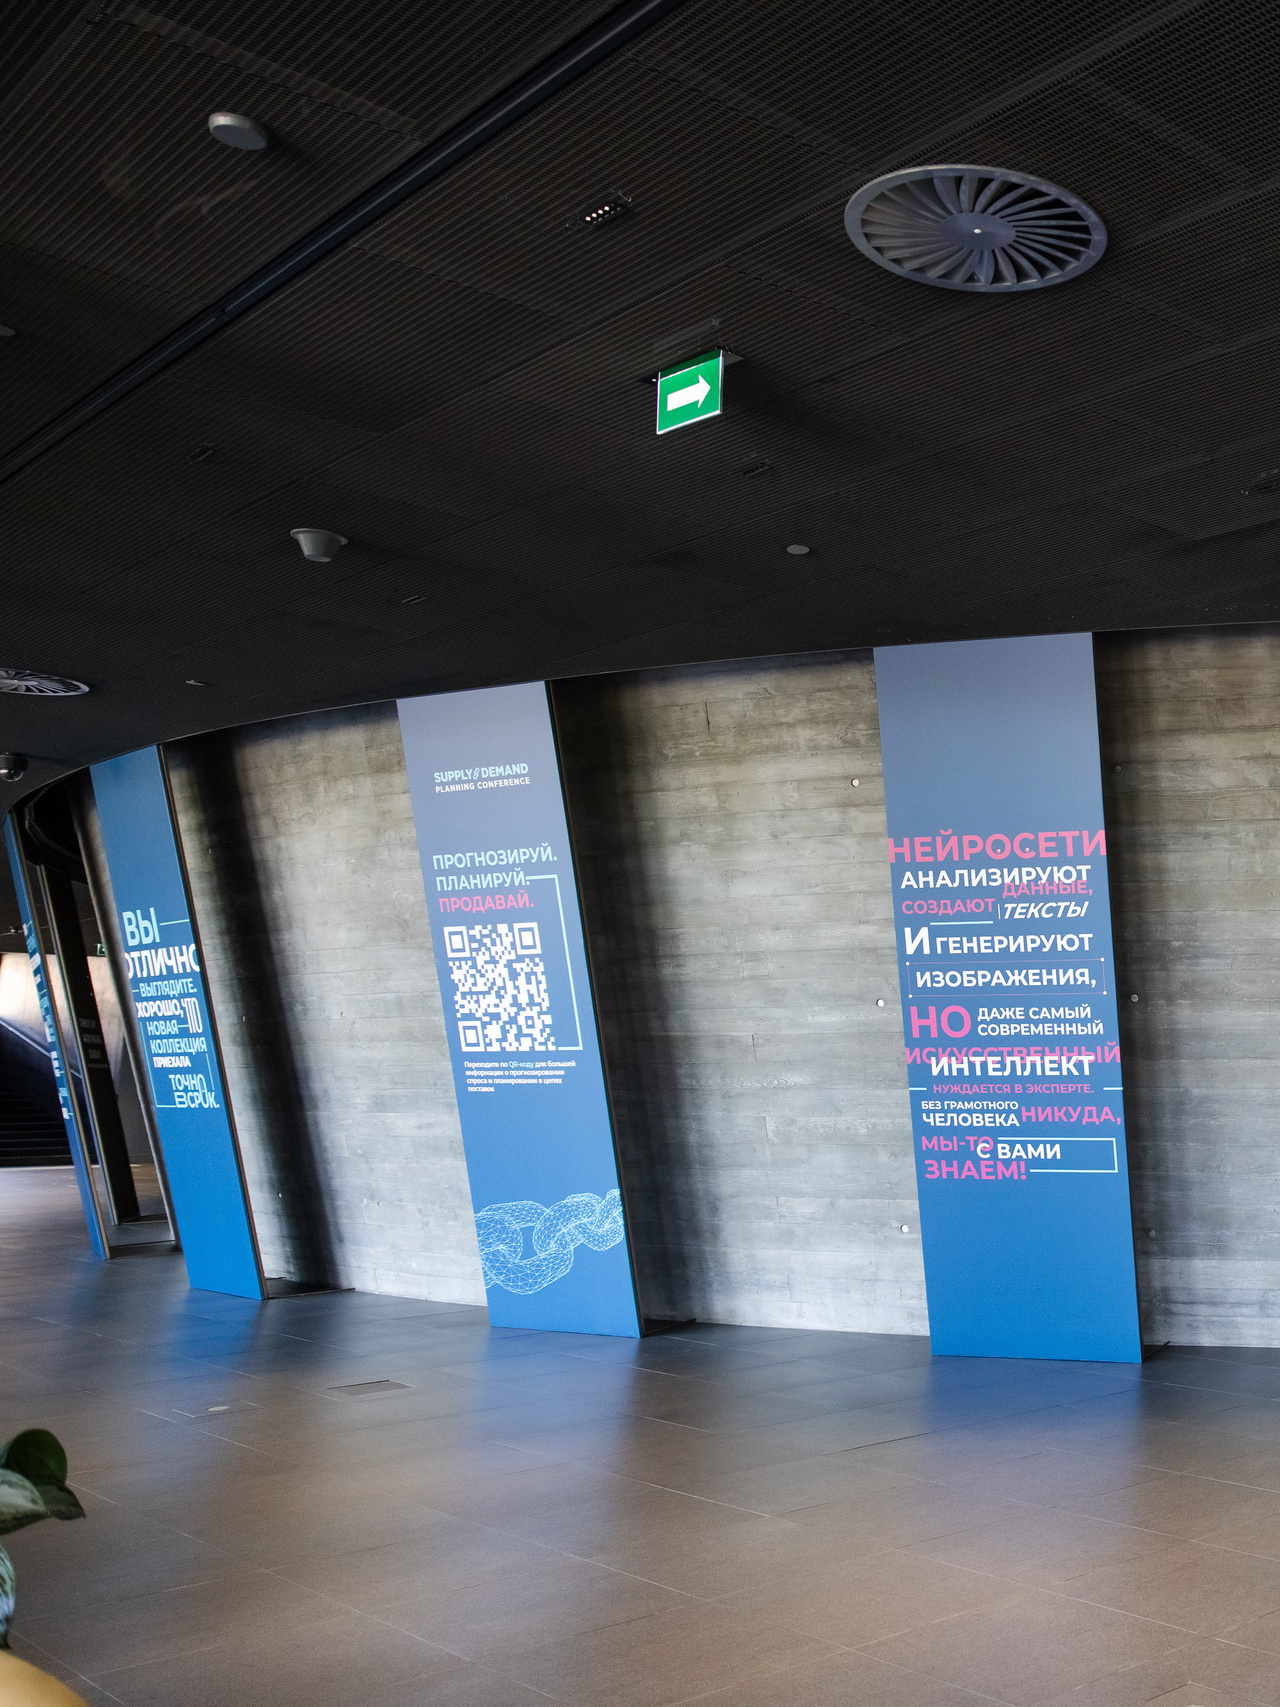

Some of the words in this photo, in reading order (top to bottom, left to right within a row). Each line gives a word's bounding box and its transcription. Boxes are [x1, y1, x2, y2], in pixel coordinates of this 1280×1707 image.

[434, 768, 472, 783] SUPPLY
[481, 763, 529, 778] DEMAND
[435, 782, 475, 793] PLANNING
[477, 777, 531, 789] CONFERENCE
[888, 828, 1107, 863] НЕЙРОСЕТИ
[432, 842, 558, 870] ПРОГНОЗИРУЙ.
[435, 867, 530, 892] ПЛАНИРУЙ.
[901, 865, 1091, 889] АНАЛИЗИРУЮТ
[1002, 880, 1093, 898] ДАННЫЕ,
[438, 889, 534, 914] ПРОДАВАЙ.
[901, 898, 995, 916] СОЗДАЮТ
[1003, 901, 1089, 919] ТЕКСТЫ
[122, 907, 160, 947] ВЫ
[904, 926, 931, 955] И
[936, 933, 1093, 954] ГЕНЕРИРУЮТ
[139, 978, 197, 998] ВЫГЛЯДИТЕ.
[916, 968, 1097, 988] ИЗОБРАЖЕНИЯ,
[135, 999, 184, 1018] ХОРОШО,
[180, 997, 203, 1033] ЧТО
[910, 1005, 971, 1038] НО
[977, 1007, 1025, 1021] ДАЖЕ
[1028, 1004, 1092, 1020] САМЫЙ
[146, 1020, 179, 1036] НОВАЯ
[977, 1020, 1104, 1036] СОВРЕМЕННЫЙ
[149, 1037, 208, 1055] КОЛЛЕКЦИЯ
[905, 1041, 1121, 1065] ИСКУССТВЕННЫЙ
[153, 1056, 192, 1068] ПРИЕХАЛА
[508, 1061, 534, 1069] QR-коду
[930, 1055, 1094, 1076] ИНТЕЛЛЕКТ
[168, 1073, 207, 1091] ТОЧНО
[933, 1084, 1011, 1095] НУЖДАЕТСЯ
[1014, 1084, 1023, 1094] В
[1026, 1083, 1094, 1094] ЭКСПЕРТЕ.
[921, 1101, 941, 1110] БЕЗ
[944, 1101, 1019, 1110] ГРАМОТНОГО
[922, 1112, 1020, 1127] ЧЕЛОВЕКА
[1021, 1106, 1121, 1126] НИКУДА,
[921, 1136, 994, 1152] МЫ-ТО
[976, 1143, 991, 1159] С
[997, 1143, 1061, 1160] ВАМИ
[924, 1159, 1027, 1181] ЗНАЕМ!
